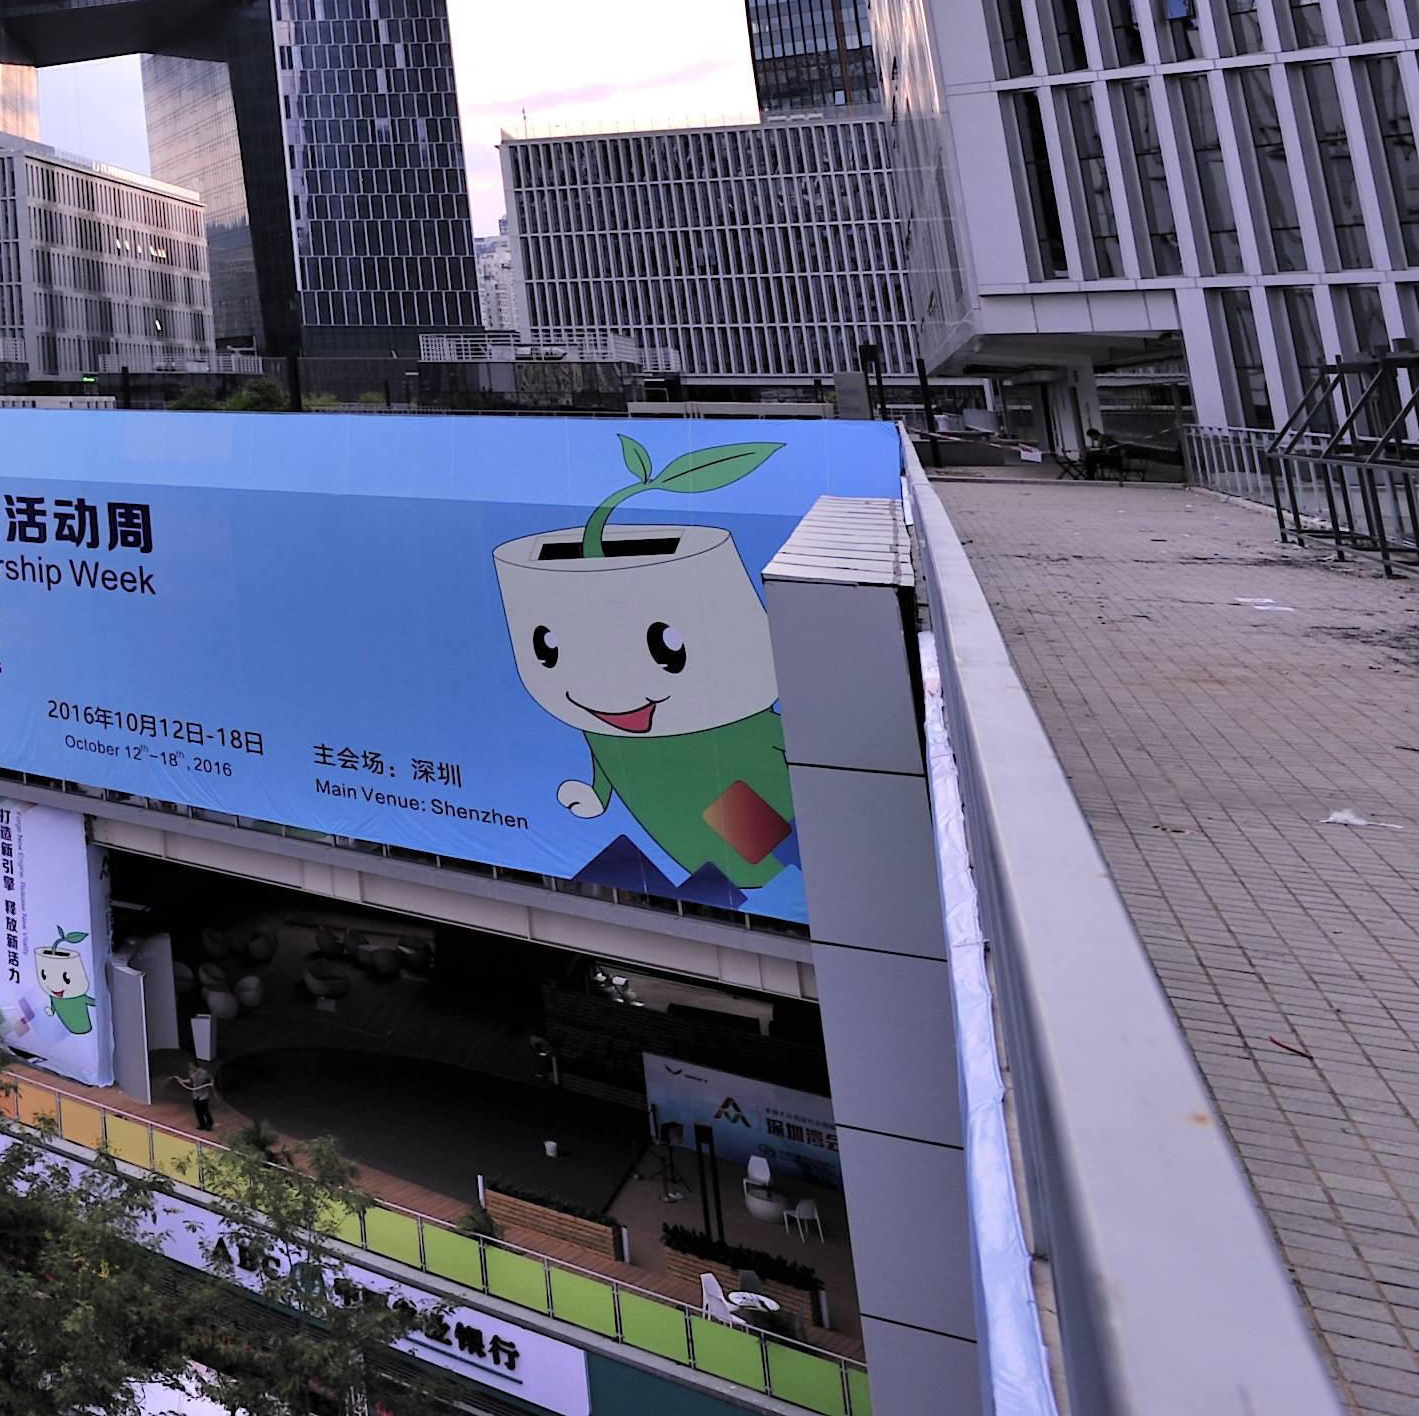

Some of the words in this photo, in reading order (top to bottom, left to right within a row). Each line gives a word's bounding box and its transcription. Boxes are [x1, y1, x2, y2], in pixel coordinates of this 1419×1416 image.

[69, 559, 157, 595] Week
[47, 699, 264, 756] 2016年10月12日-18日
[64, 735, 120, 757] October
[193, 756, 233, 777] 2016
[315, 778, 357, 800] Main
[362, 785, 426, 813] Venue:
[431, 797, 529, 831] Shenzhen
[0, 808, 16, 891] 打造新引擎
[4, 899, 20, 984] 释放新活力
